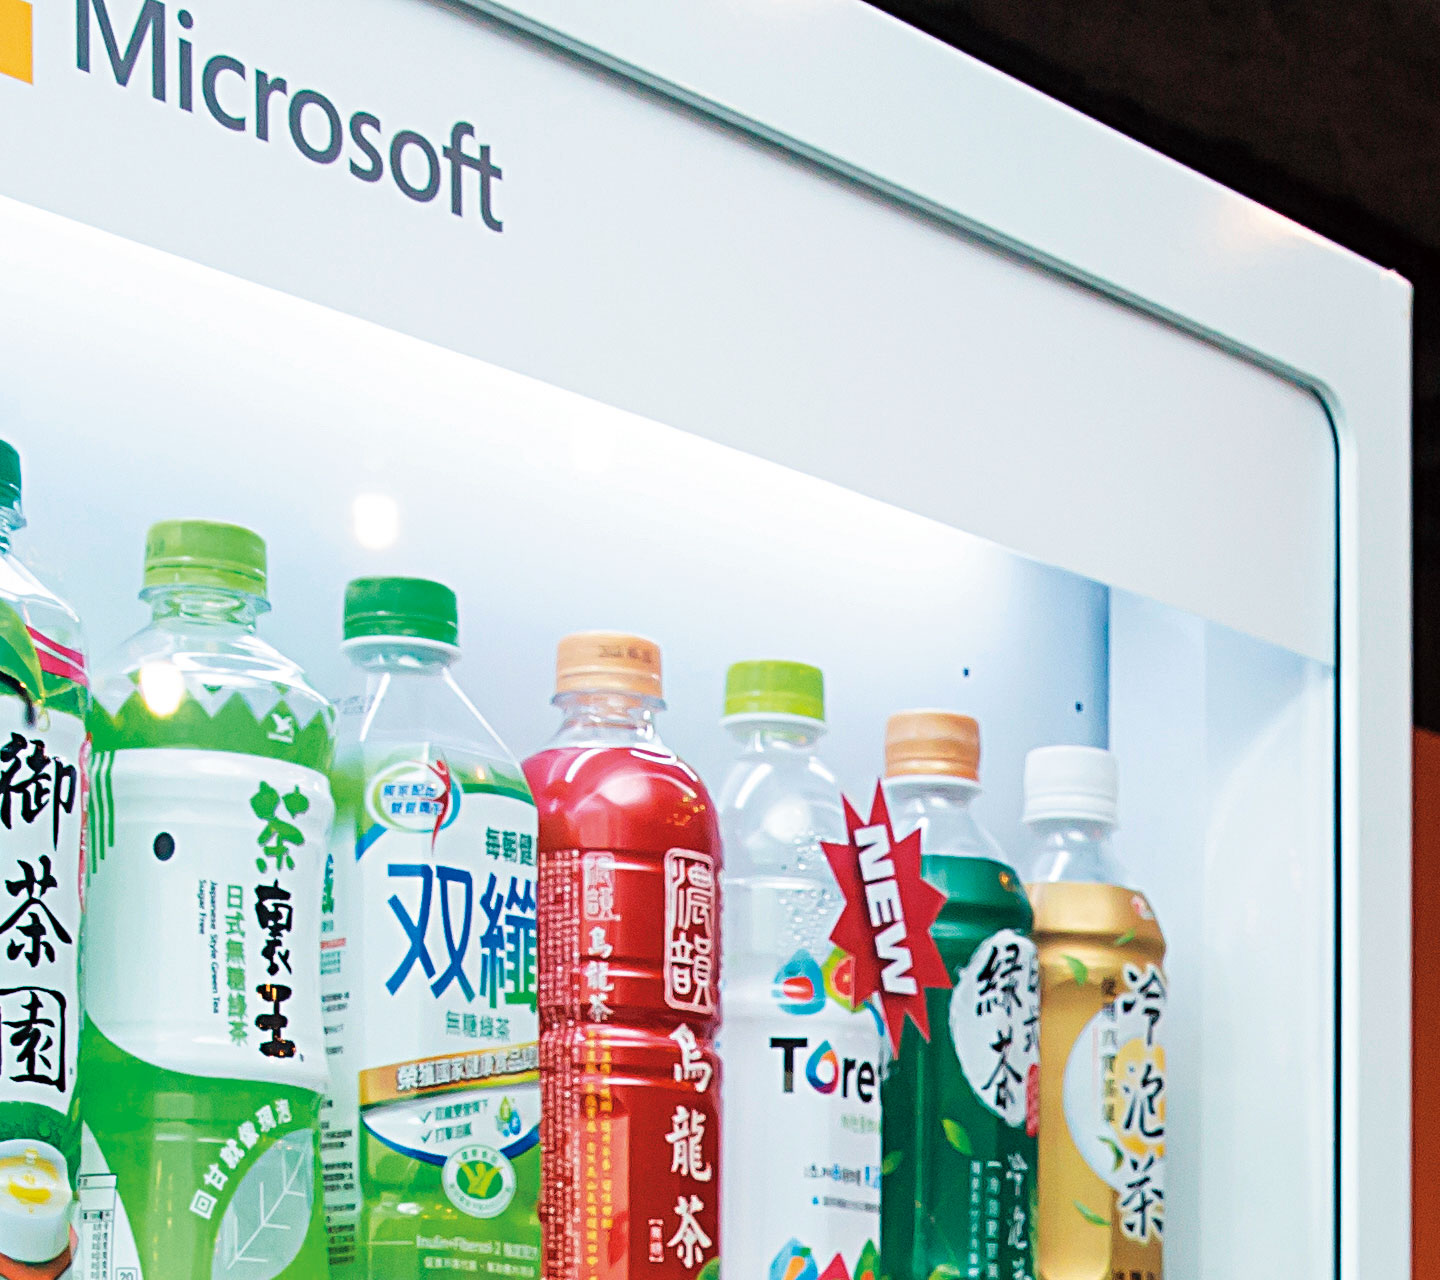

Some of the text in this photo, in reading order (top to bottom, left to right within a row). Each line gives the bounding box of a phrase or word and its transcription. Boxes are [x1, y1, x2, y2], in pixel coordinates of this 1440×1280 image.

[76, 0, 504, 232] Microsoft
[250, 781, 309, 1058] 茶裏王
[855, 824, 917, 997] NEW
[666, 1023, 712, 1268] 烏龍茶
